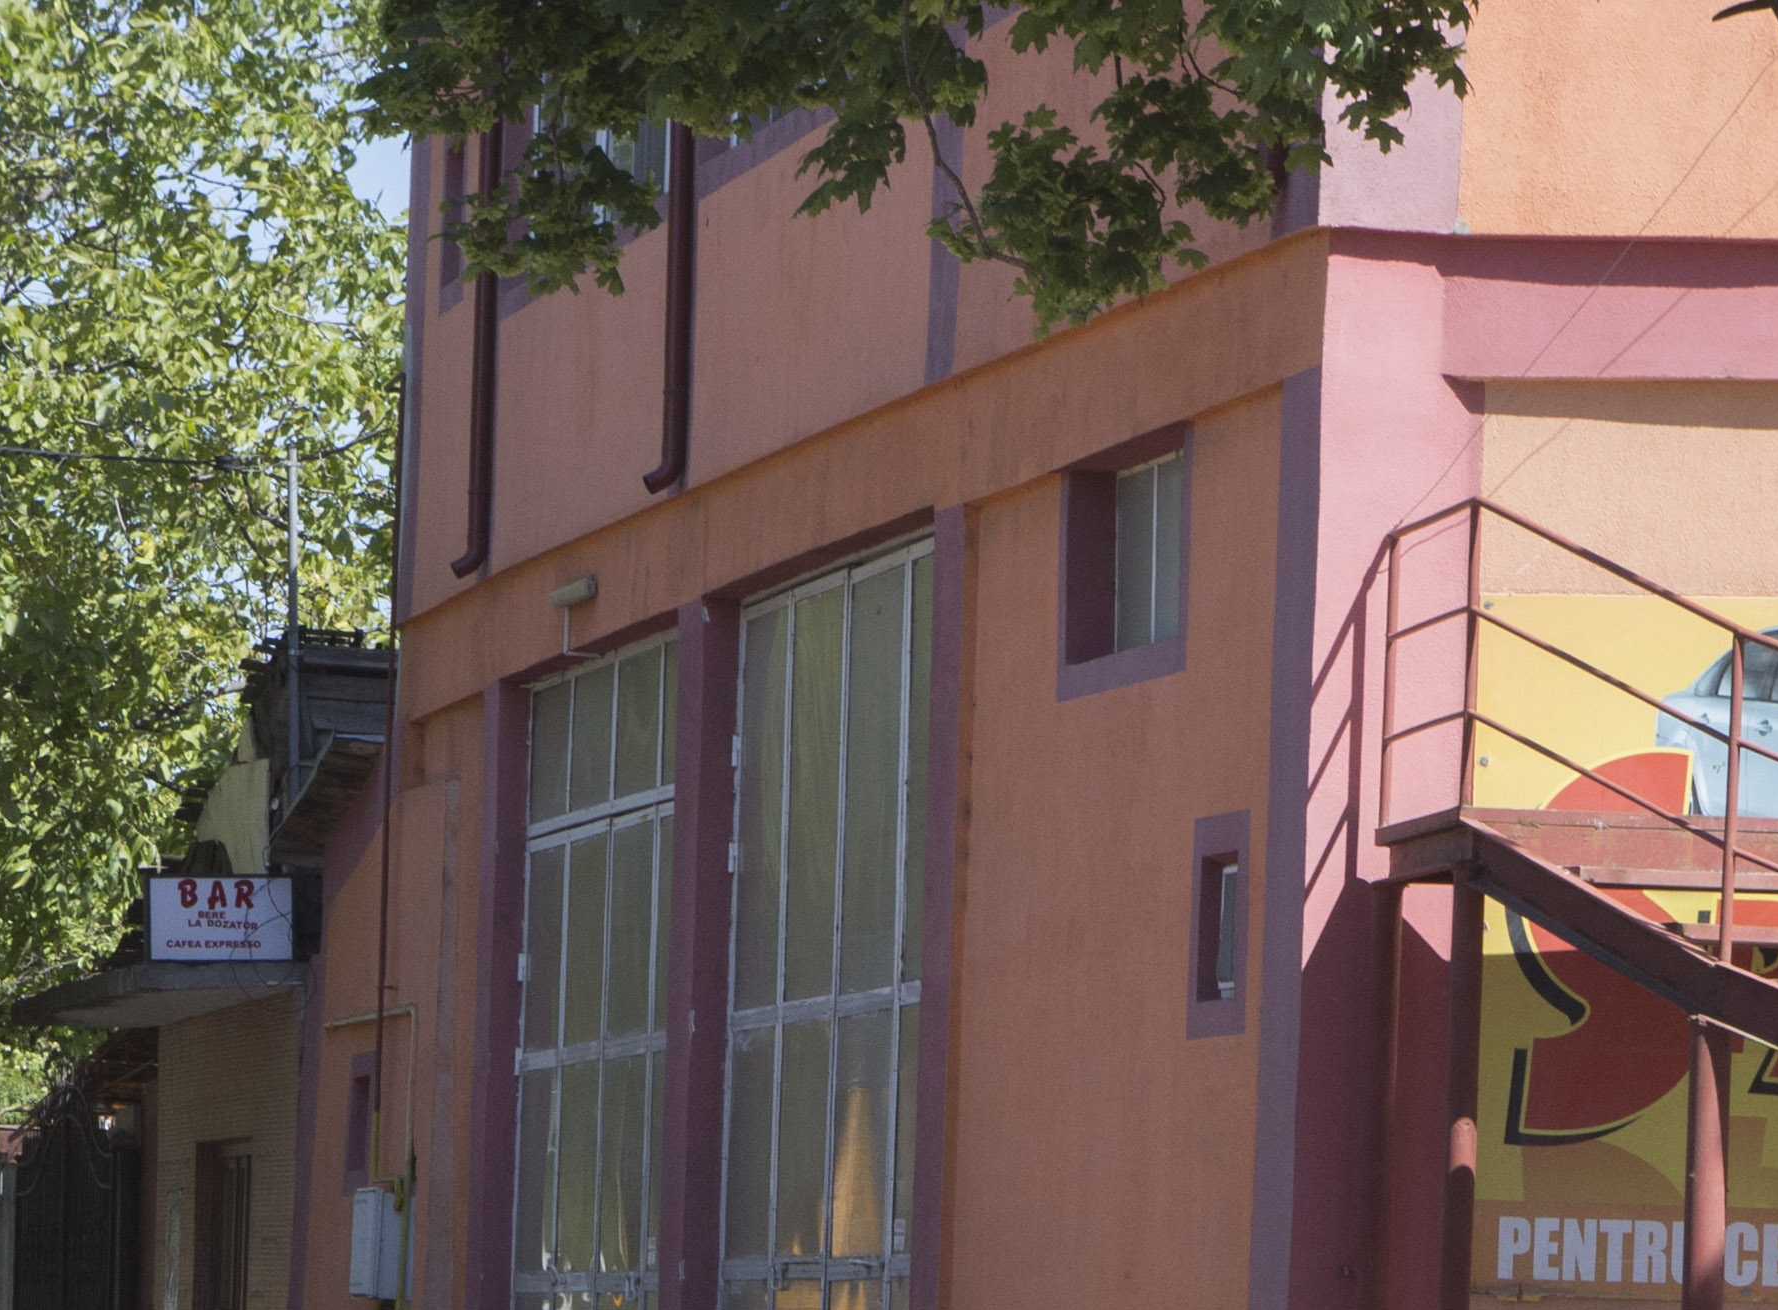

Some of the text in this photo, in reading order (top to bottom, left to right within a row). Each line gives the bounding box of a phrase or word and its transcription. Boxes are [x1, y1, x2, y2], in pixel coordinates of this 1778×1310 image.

[177, 878, 255, 910] BAR
[197, 911, 227, 919] BERE
[187, 919, 258, 930] LA DOZATOR
[166, 940, 262, 949] CAFEA EXPRESSO
